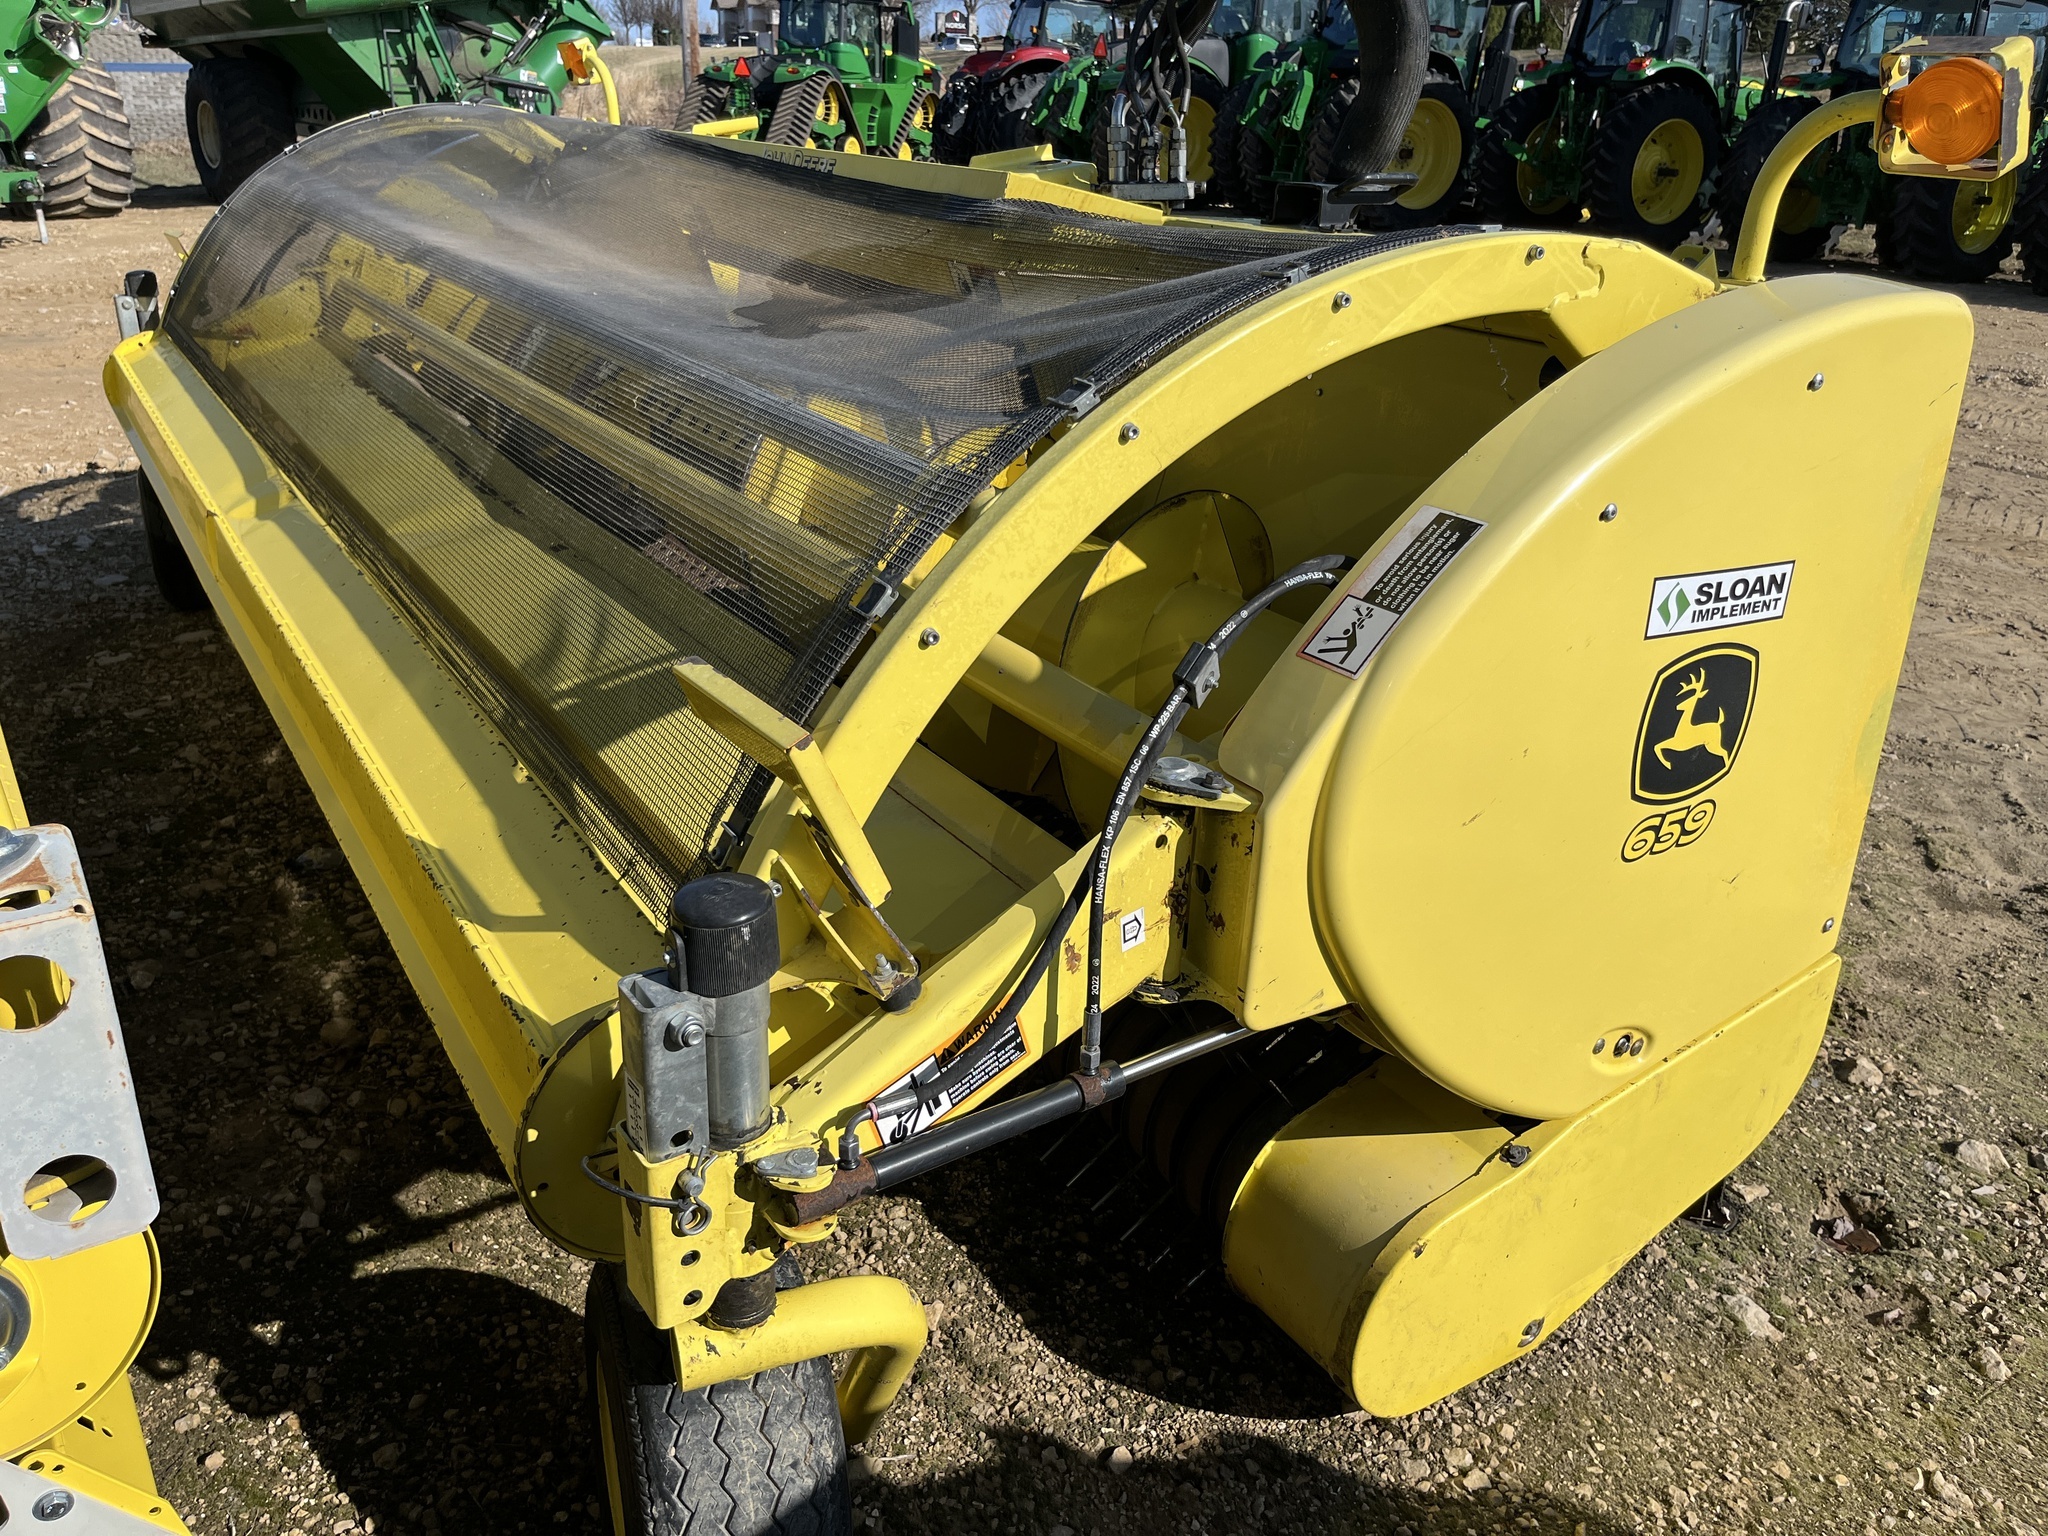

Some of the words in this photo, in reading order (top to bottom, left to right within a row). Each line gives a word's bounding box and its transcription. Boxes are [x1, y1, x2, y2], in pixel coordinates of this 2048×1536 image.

[945, 22, 967, 30] NORSK
[1373, 582, 1384, 591] To
[1383, 565, 1399, 582] avoid
[1399, 542, 1420, 564] serious
[1382, 596, 1392, 606] do
[1390, 584, 1403, 597] not
[1401, 567, 1417, 584] allow
[1443, 529, 1452, 538] or
[1391, 583, 1415, 608] clothing
[1412, 574, 1422, 582] to
[1418, 565, 1430, 574] be
[1428, 549, 1443, 565] near
[1442, 532, 1460, 549] auger
[1284, 572, 1324, 588] HANSA-FLEX
[1374, 594, 1383, 604] or
[1382, 577, 1399, 594] death
[1398, 561, 1413, 575] from
[1398, 594, 1415, 611] when
[1412, 585, 1421, 595] it
[1423, 573, 1433, 581] in
[1432, 550, 1455, 572] motion.
[1694, 572, 1787, 606] SLOAN
[1690, 597, 1782, 624] IMPLEMENT
[1166, 694, 1182, 713] BAR
[1158, 710, 1170, 726] 225
[1149, 724, 1161, 740] WP
[1129, 758, 1141, 775] 1SC
[1121, 776, 1132, 792] 857
[1116, 792, 1127, 806] EN
[1109, 810, 1120, 824] 106
[1104, 826, 1114, 840] KP
[1620, 798, 1716, 863] 659
[1094, 844, 1110, 904] HANSA-FLEX
